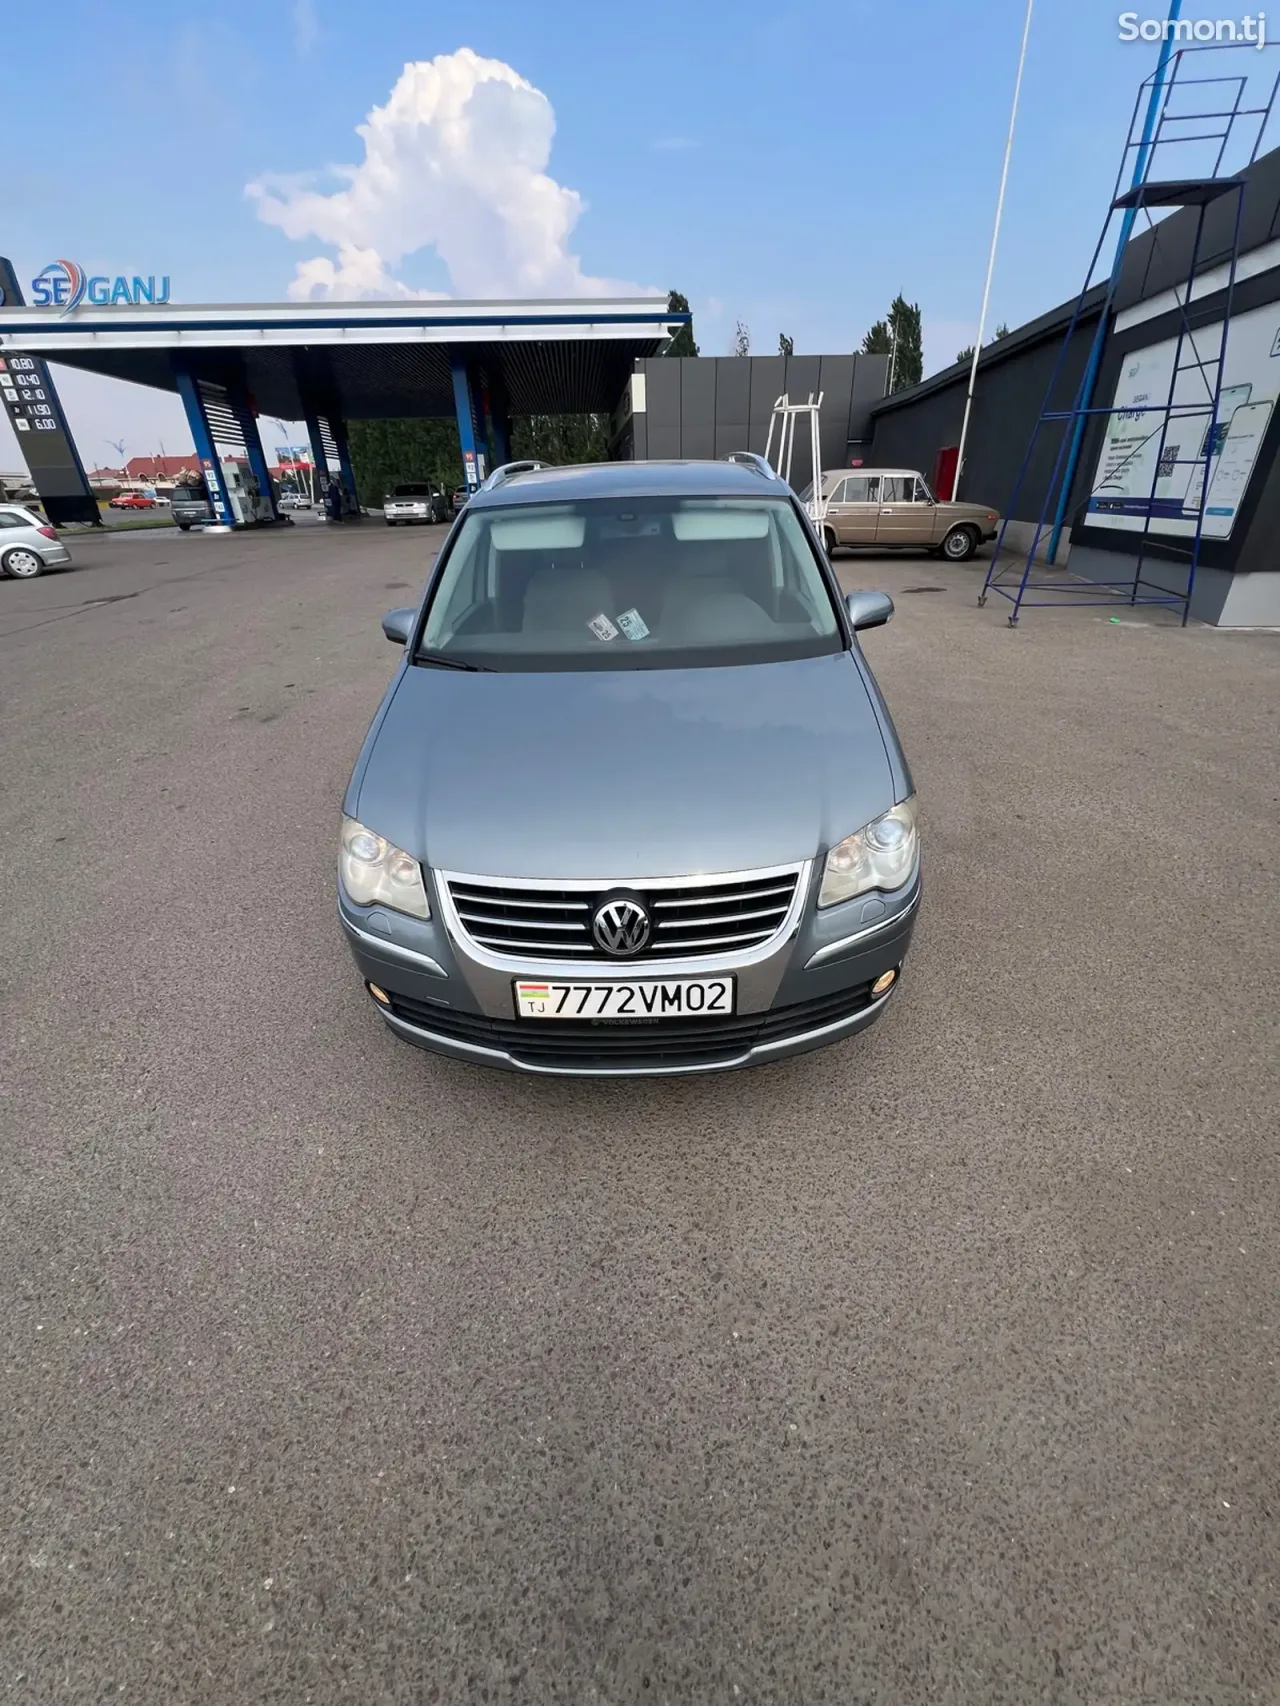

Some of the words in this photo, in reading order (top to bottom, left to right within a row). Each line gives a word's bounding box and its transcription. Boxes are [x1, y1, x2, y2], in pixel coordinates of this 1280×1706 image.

[10, 358, 35, 370] 10.80
[16, 374, 41, 386] 10.40
[22, 388, 46, 400] 12.10
[34, 418, 57, 430] 6.00
[620, 615, 632, 628] 25
[551, 981, 727, 1014] 7772VM02
[527, 1001, 545, 1013] TJ
